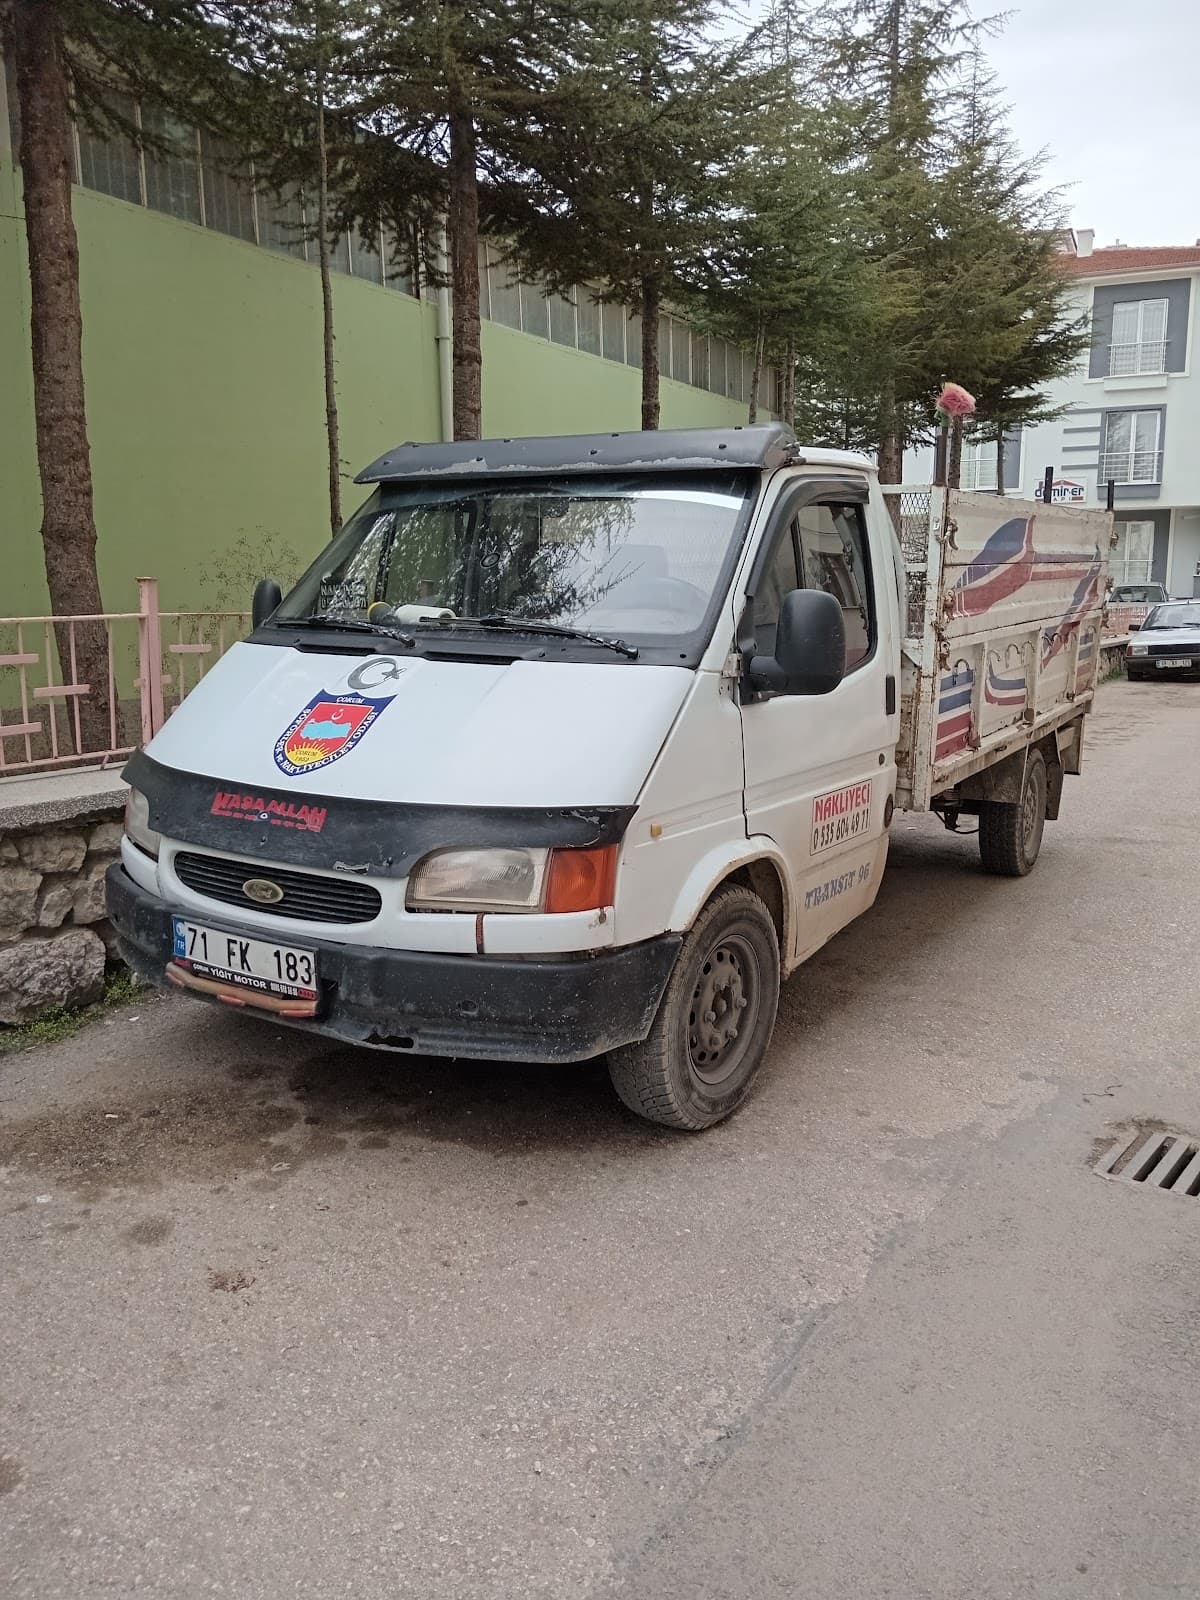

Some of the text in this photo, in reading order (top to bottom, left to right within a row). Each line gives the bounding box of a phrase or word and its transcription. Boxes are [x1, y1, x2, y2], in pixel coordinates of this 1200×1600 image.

[1035, 481, 1084, 497] dmirer
[813, 807, 869, 849] 0 535 604 49 71
[858, 862, 871, 885] 96
[177, 939, 186, 951] TR
[187, 927, 313, 985] 71 FK 183
[233, 973, 267, 990] MOTOR
